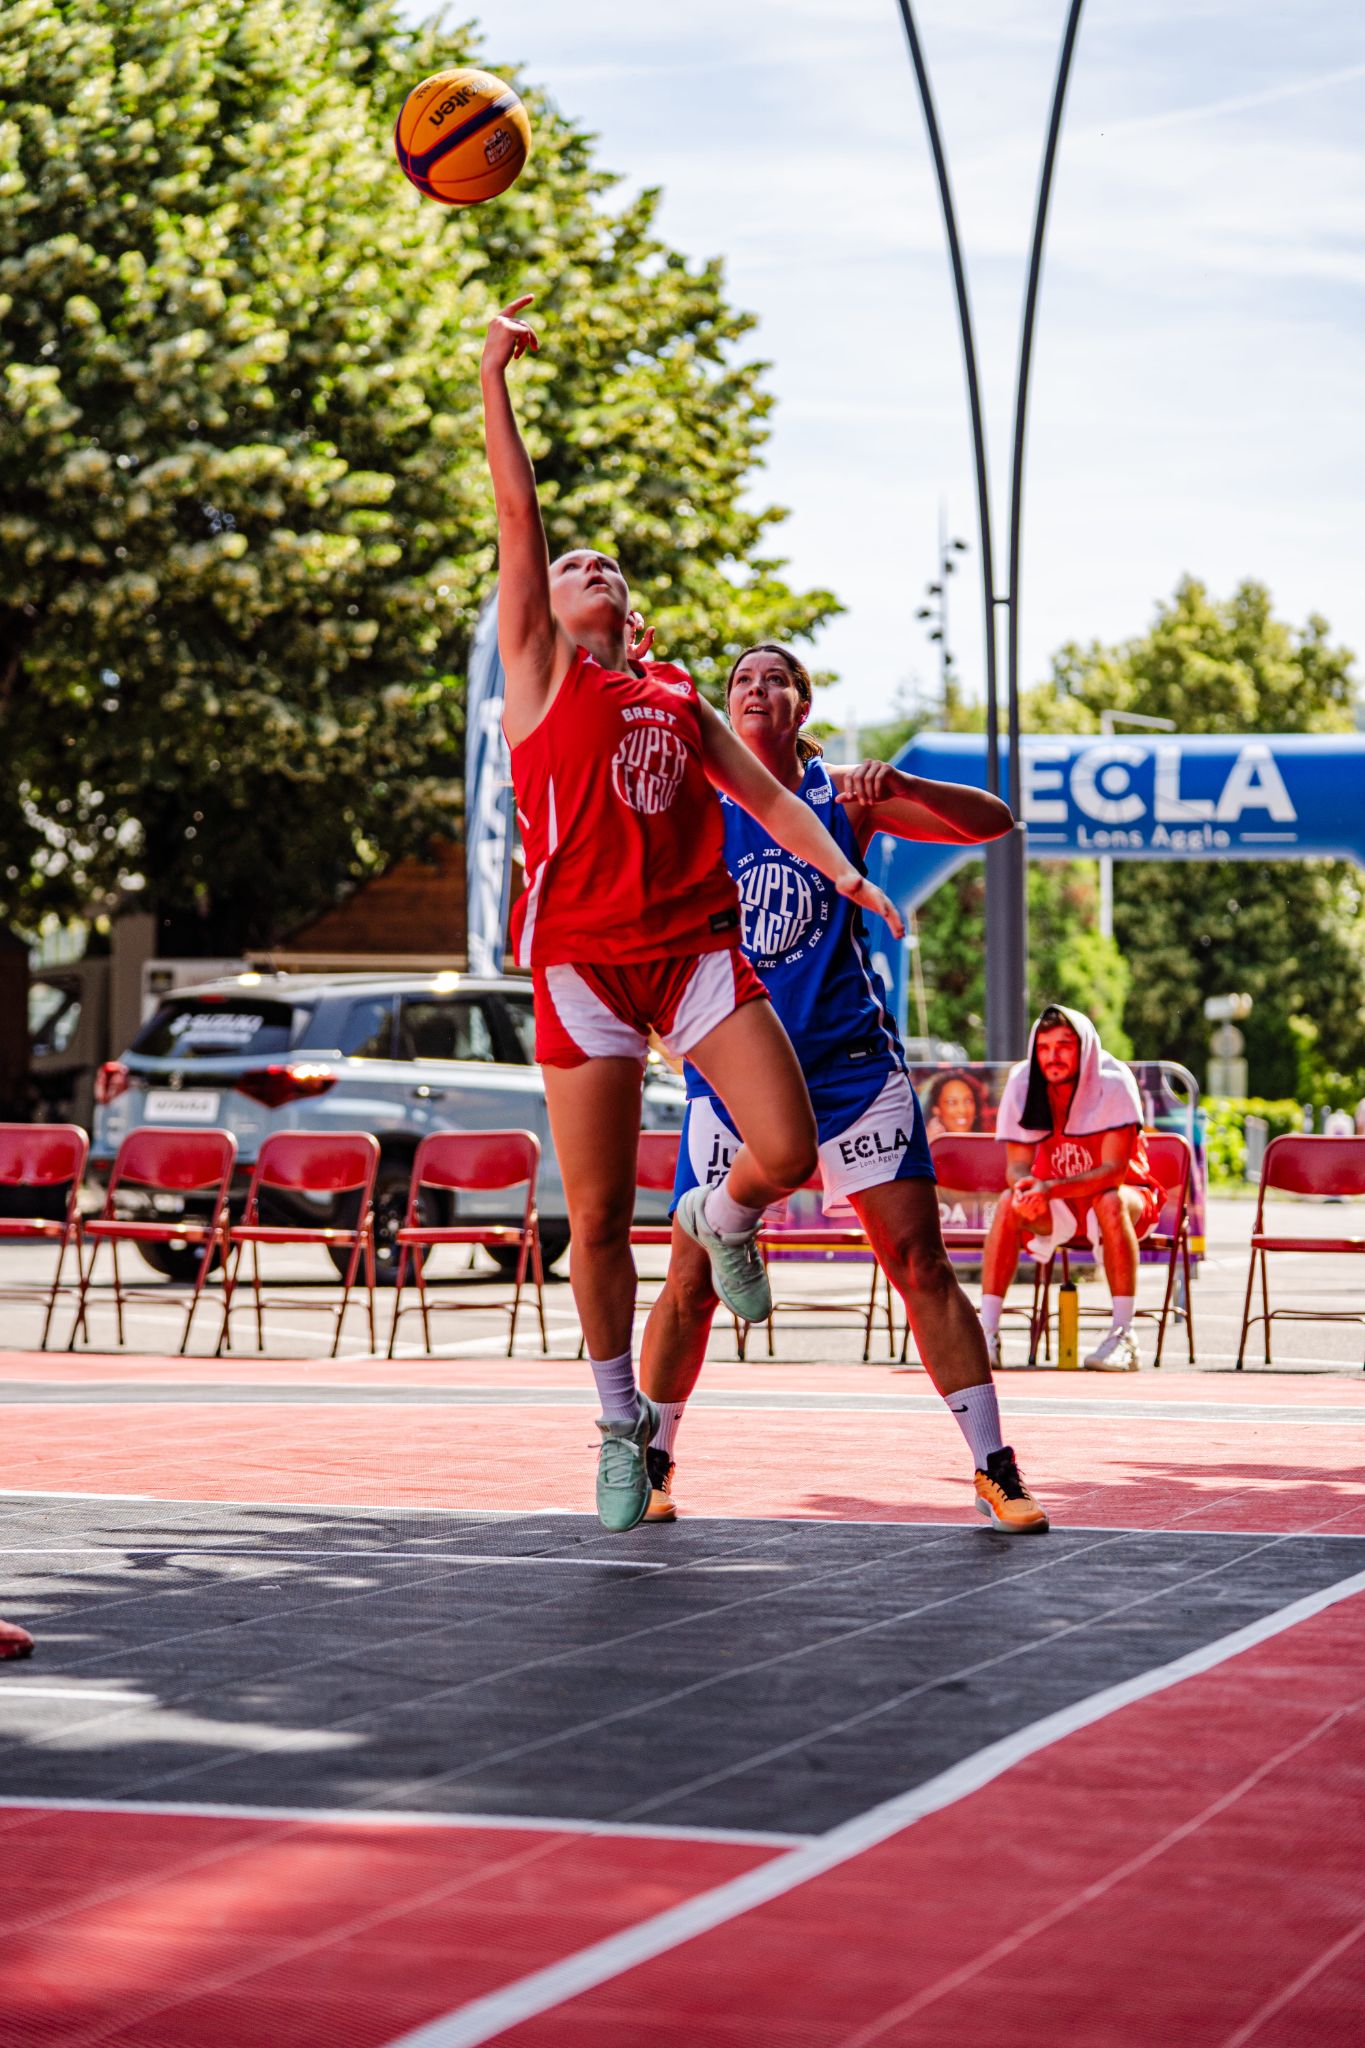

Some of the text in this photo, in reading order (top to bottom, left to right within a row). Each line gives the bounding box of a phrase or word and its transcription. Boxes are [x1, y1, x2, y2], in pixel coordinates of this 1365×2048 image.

[621, 706, 677, 726] BREST
[612, 726, 688, 781] SUPER
[611, 763, 682, 814] LEAGUE
[1018, 743, 1298, 824] ECLA
[1077, 823, 1231, 852] Lons Agglo
[736, 862, 812, 920] SUPER
[737, 853, 755, 868] 3X3
[762, 848, 782, 857] 3X3
[789, 853, 808, 868] 3X3
[811, 873, 825, 892] 3X3
[740, 903, 812, 955] EAGUE
[839, 1128, 911, 1165] ECLA
[860, 1153, 899, 1168] Lons Agglo
